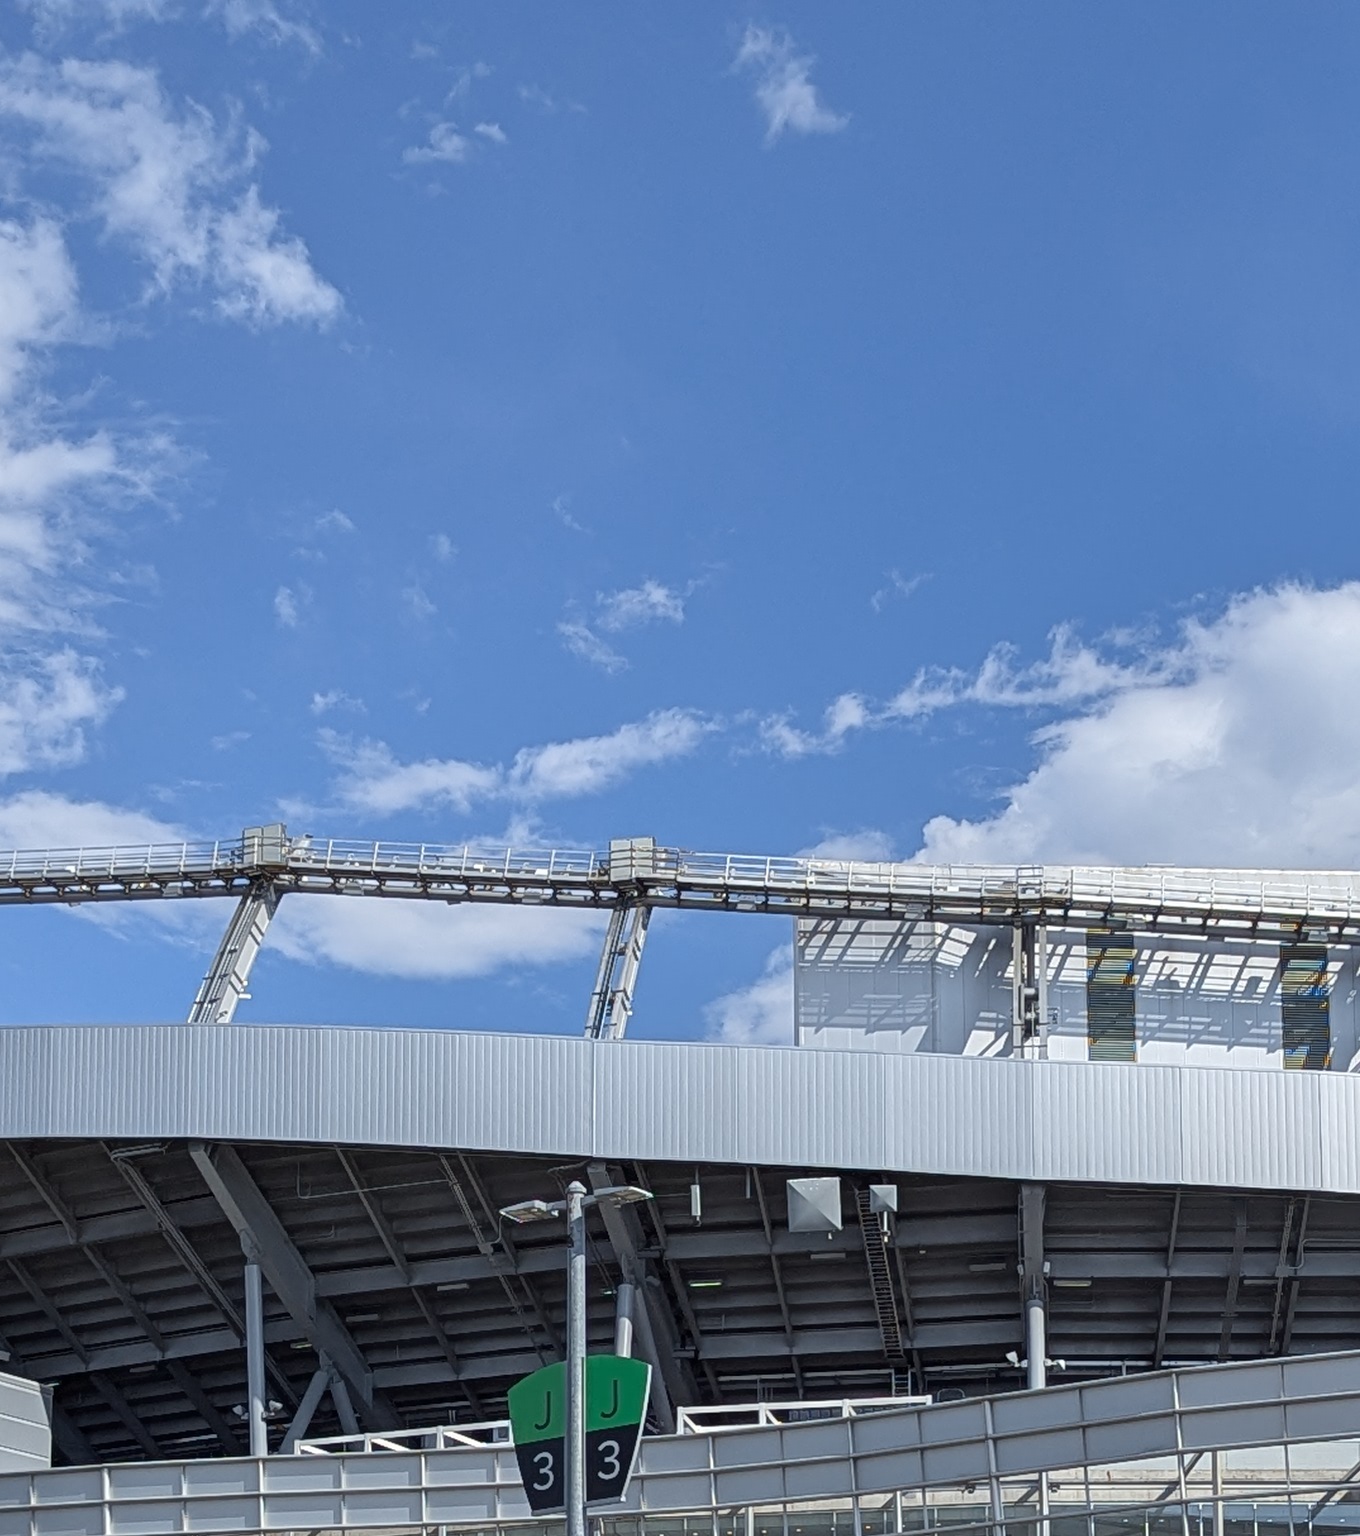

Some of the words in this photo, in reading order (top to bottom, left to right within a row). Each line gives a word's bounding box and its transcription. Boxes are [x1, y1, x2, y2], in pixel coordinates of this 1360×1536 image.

[534, 1391, 551, 1430] J
[601, 1380, 618, 1418] J
[533, 1451, 555, 1491] 3
[597, 1439, 621, 1481] 3
